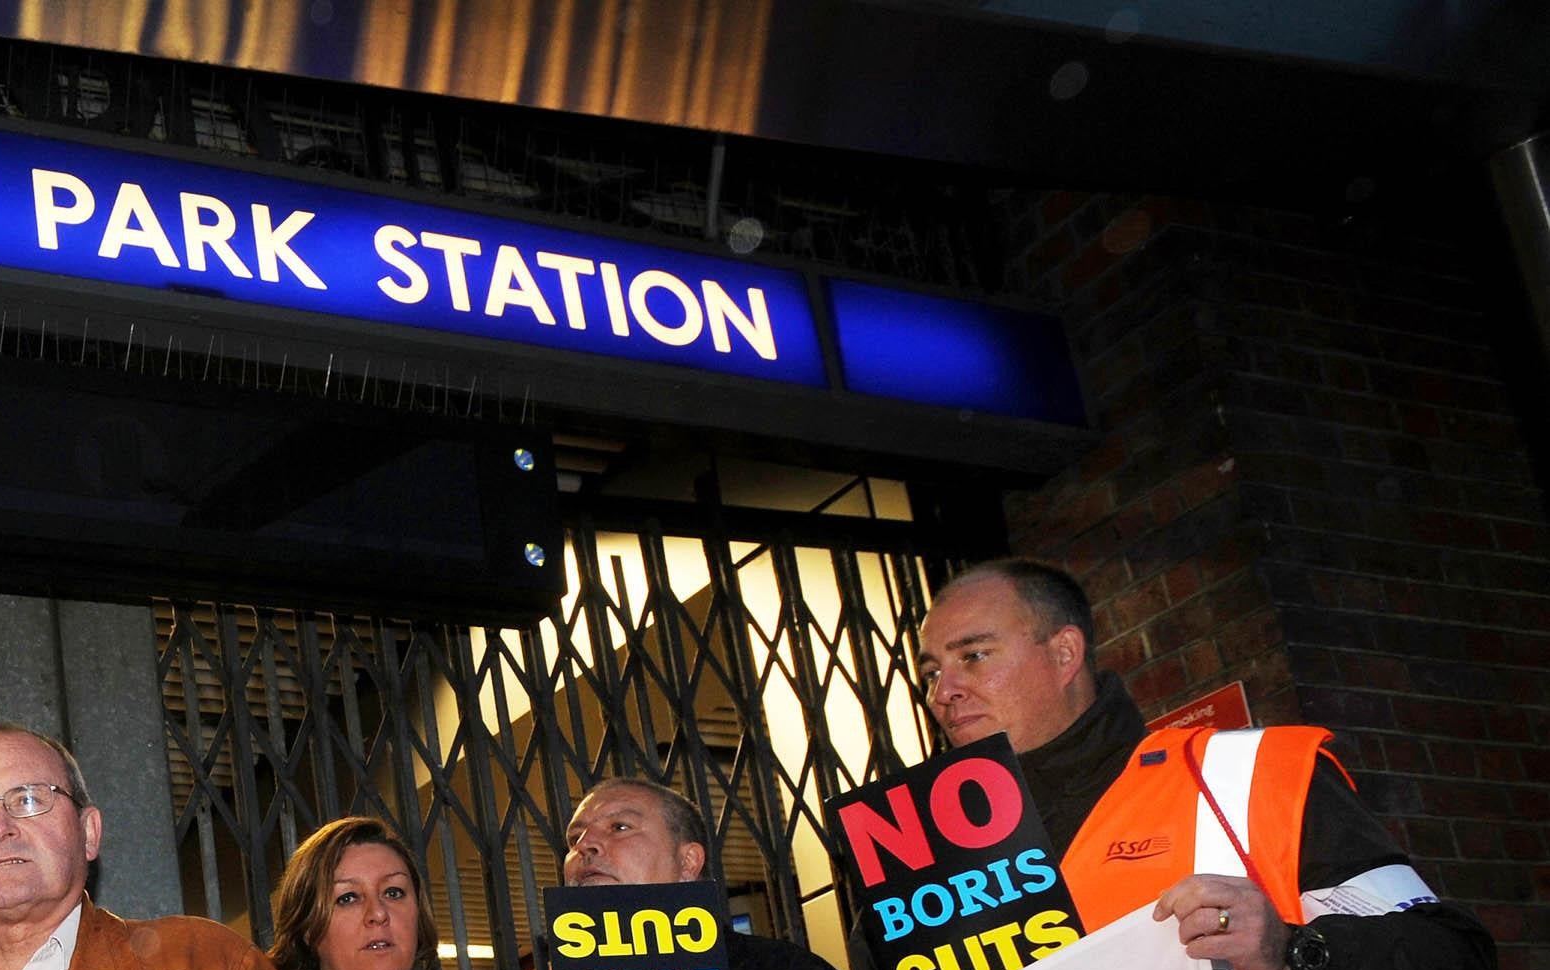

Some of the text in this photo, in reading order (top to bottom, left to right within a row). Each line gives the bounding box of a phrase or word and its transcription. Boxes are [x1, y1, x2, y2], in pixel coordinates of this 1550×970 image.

[31, 167, 328, 290] PARK
[373, 224, 778, 361] STATION
[838, 757, 1023, 888] NO
[553, 907, 718, 959] CUTS
[873, 848, 1057, 942] BORIS
